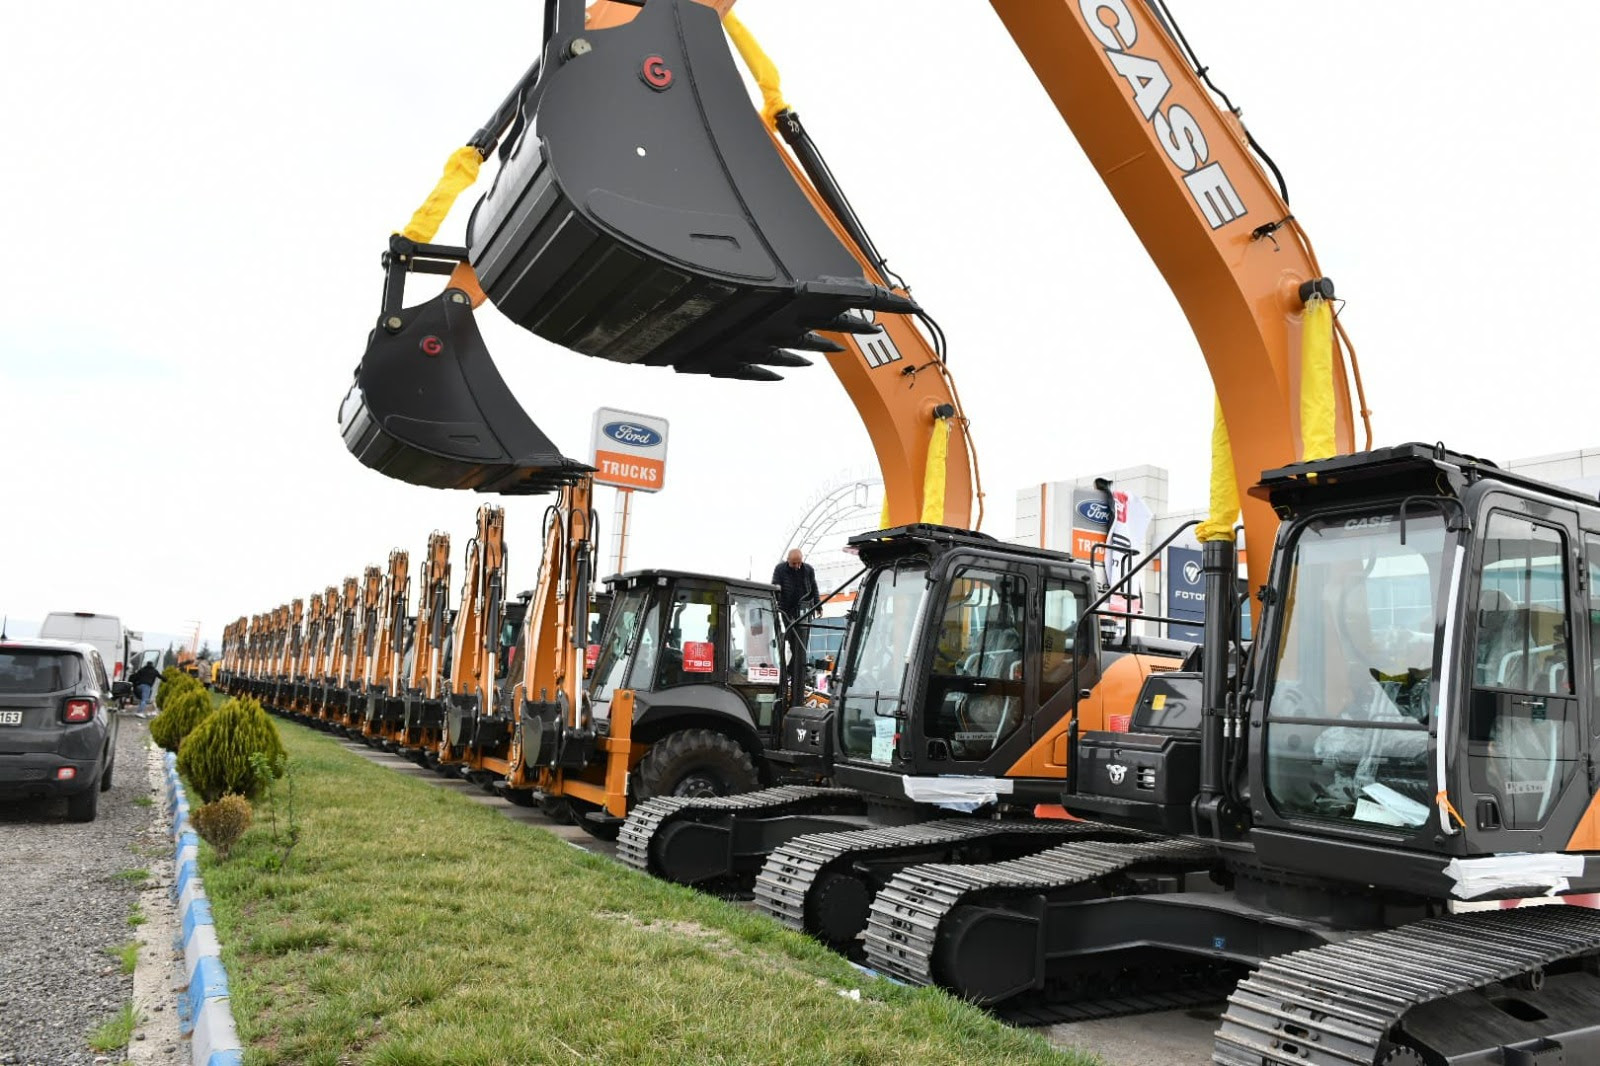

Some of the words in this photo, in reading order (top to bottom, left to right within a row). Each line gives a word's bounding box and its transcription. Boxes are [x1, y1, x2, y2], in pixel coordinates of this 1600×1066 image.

[1078, 0, 1248, 230] CASE
[614, 424, 651, 443] Ford
[602, 460, 657, 482] TRUCKS
[1344, 514, 1394, 530] CASE
